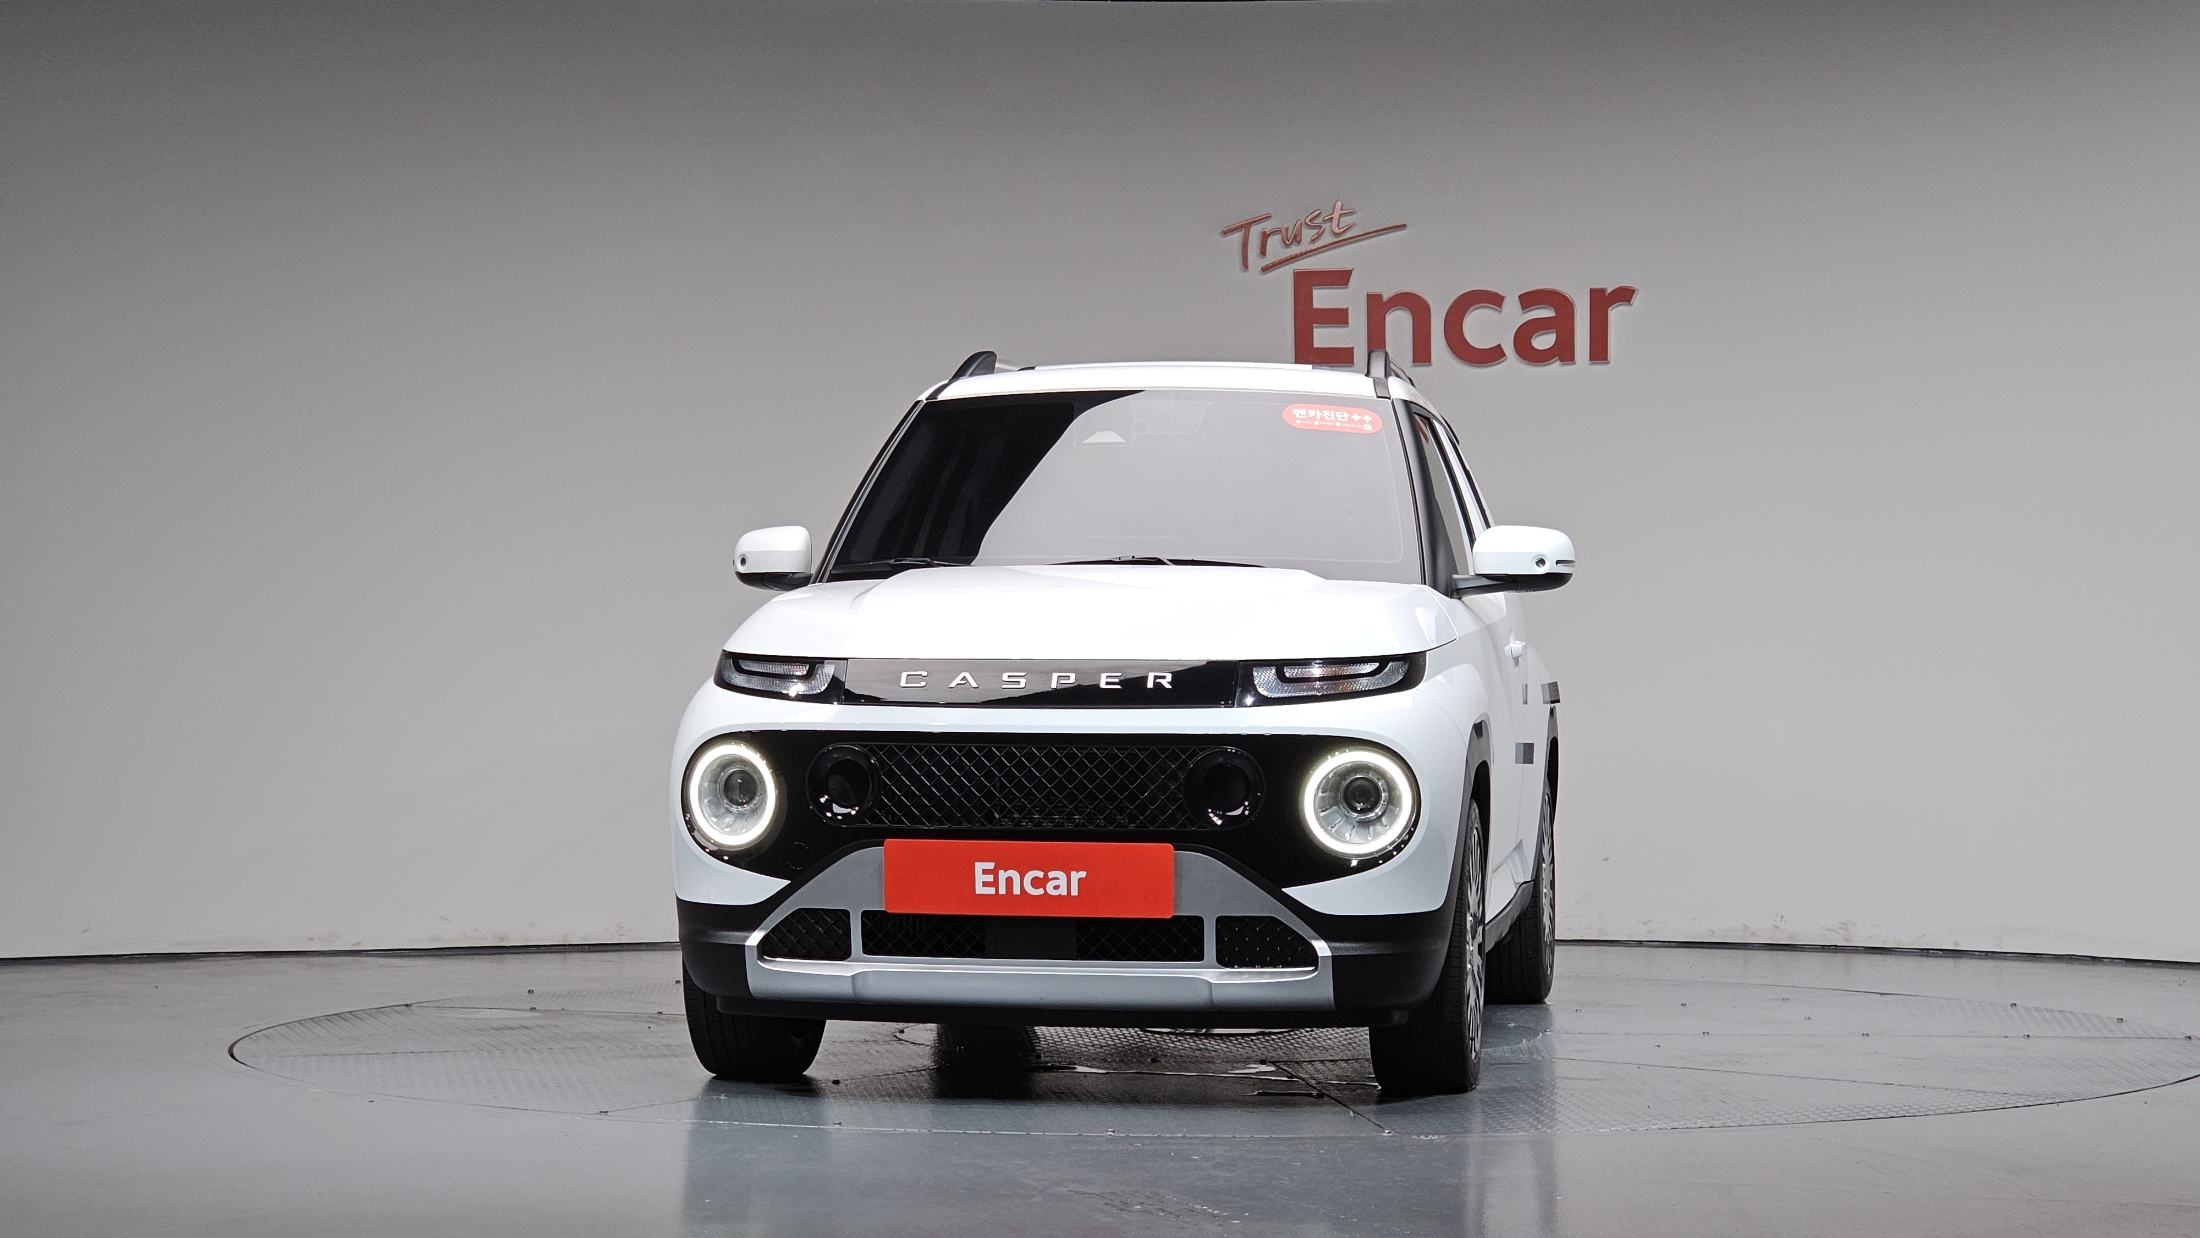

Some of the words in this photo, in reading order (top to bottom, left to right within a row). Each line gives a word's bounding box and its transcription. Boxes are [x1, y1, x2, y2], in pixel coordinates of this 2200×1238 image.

[1222, 200, 1356, 271] Trust
[1293, 267, 1639, 366] Encar
[900, 671, 1173, 689] CASPER
[974, 861, 1087, 896] Encar
